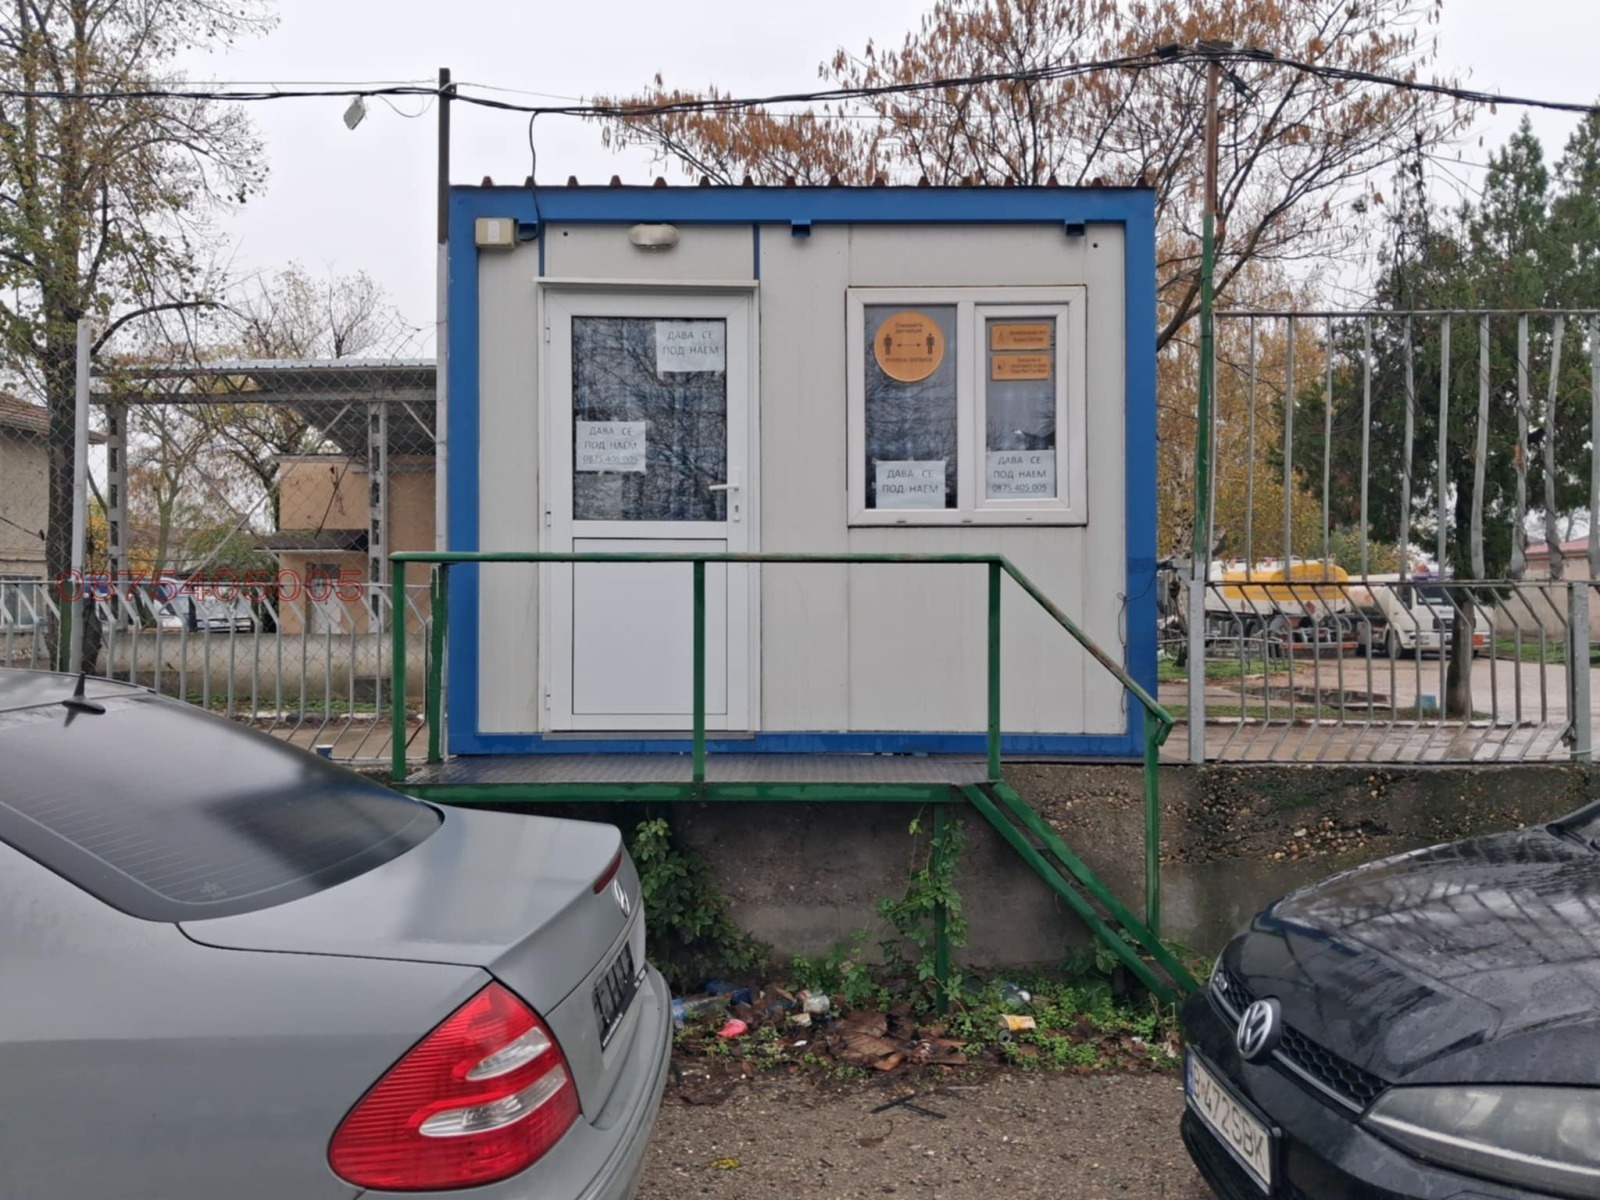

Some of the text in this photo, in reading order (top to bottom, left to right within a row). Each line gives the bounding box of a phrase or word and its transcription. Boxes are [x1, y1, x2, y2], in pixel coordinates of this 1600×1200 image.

[666, 330, 713, 341] ДАВА СЕ
[662, 345, 719, 357] ПОД НАЕМ
[588, 426, 634, 437] ДАВА СЕ
[584, 440, 606, 451] ПОД
[997, 455, 1041, 466] ДАВА СЕ
[886, 468, 935, 480] ДАВА СЕ
[993, 469, 1047, 480] ПОД НАЕМ
[881, 484, 939, 495] ПОД НАЕМ
